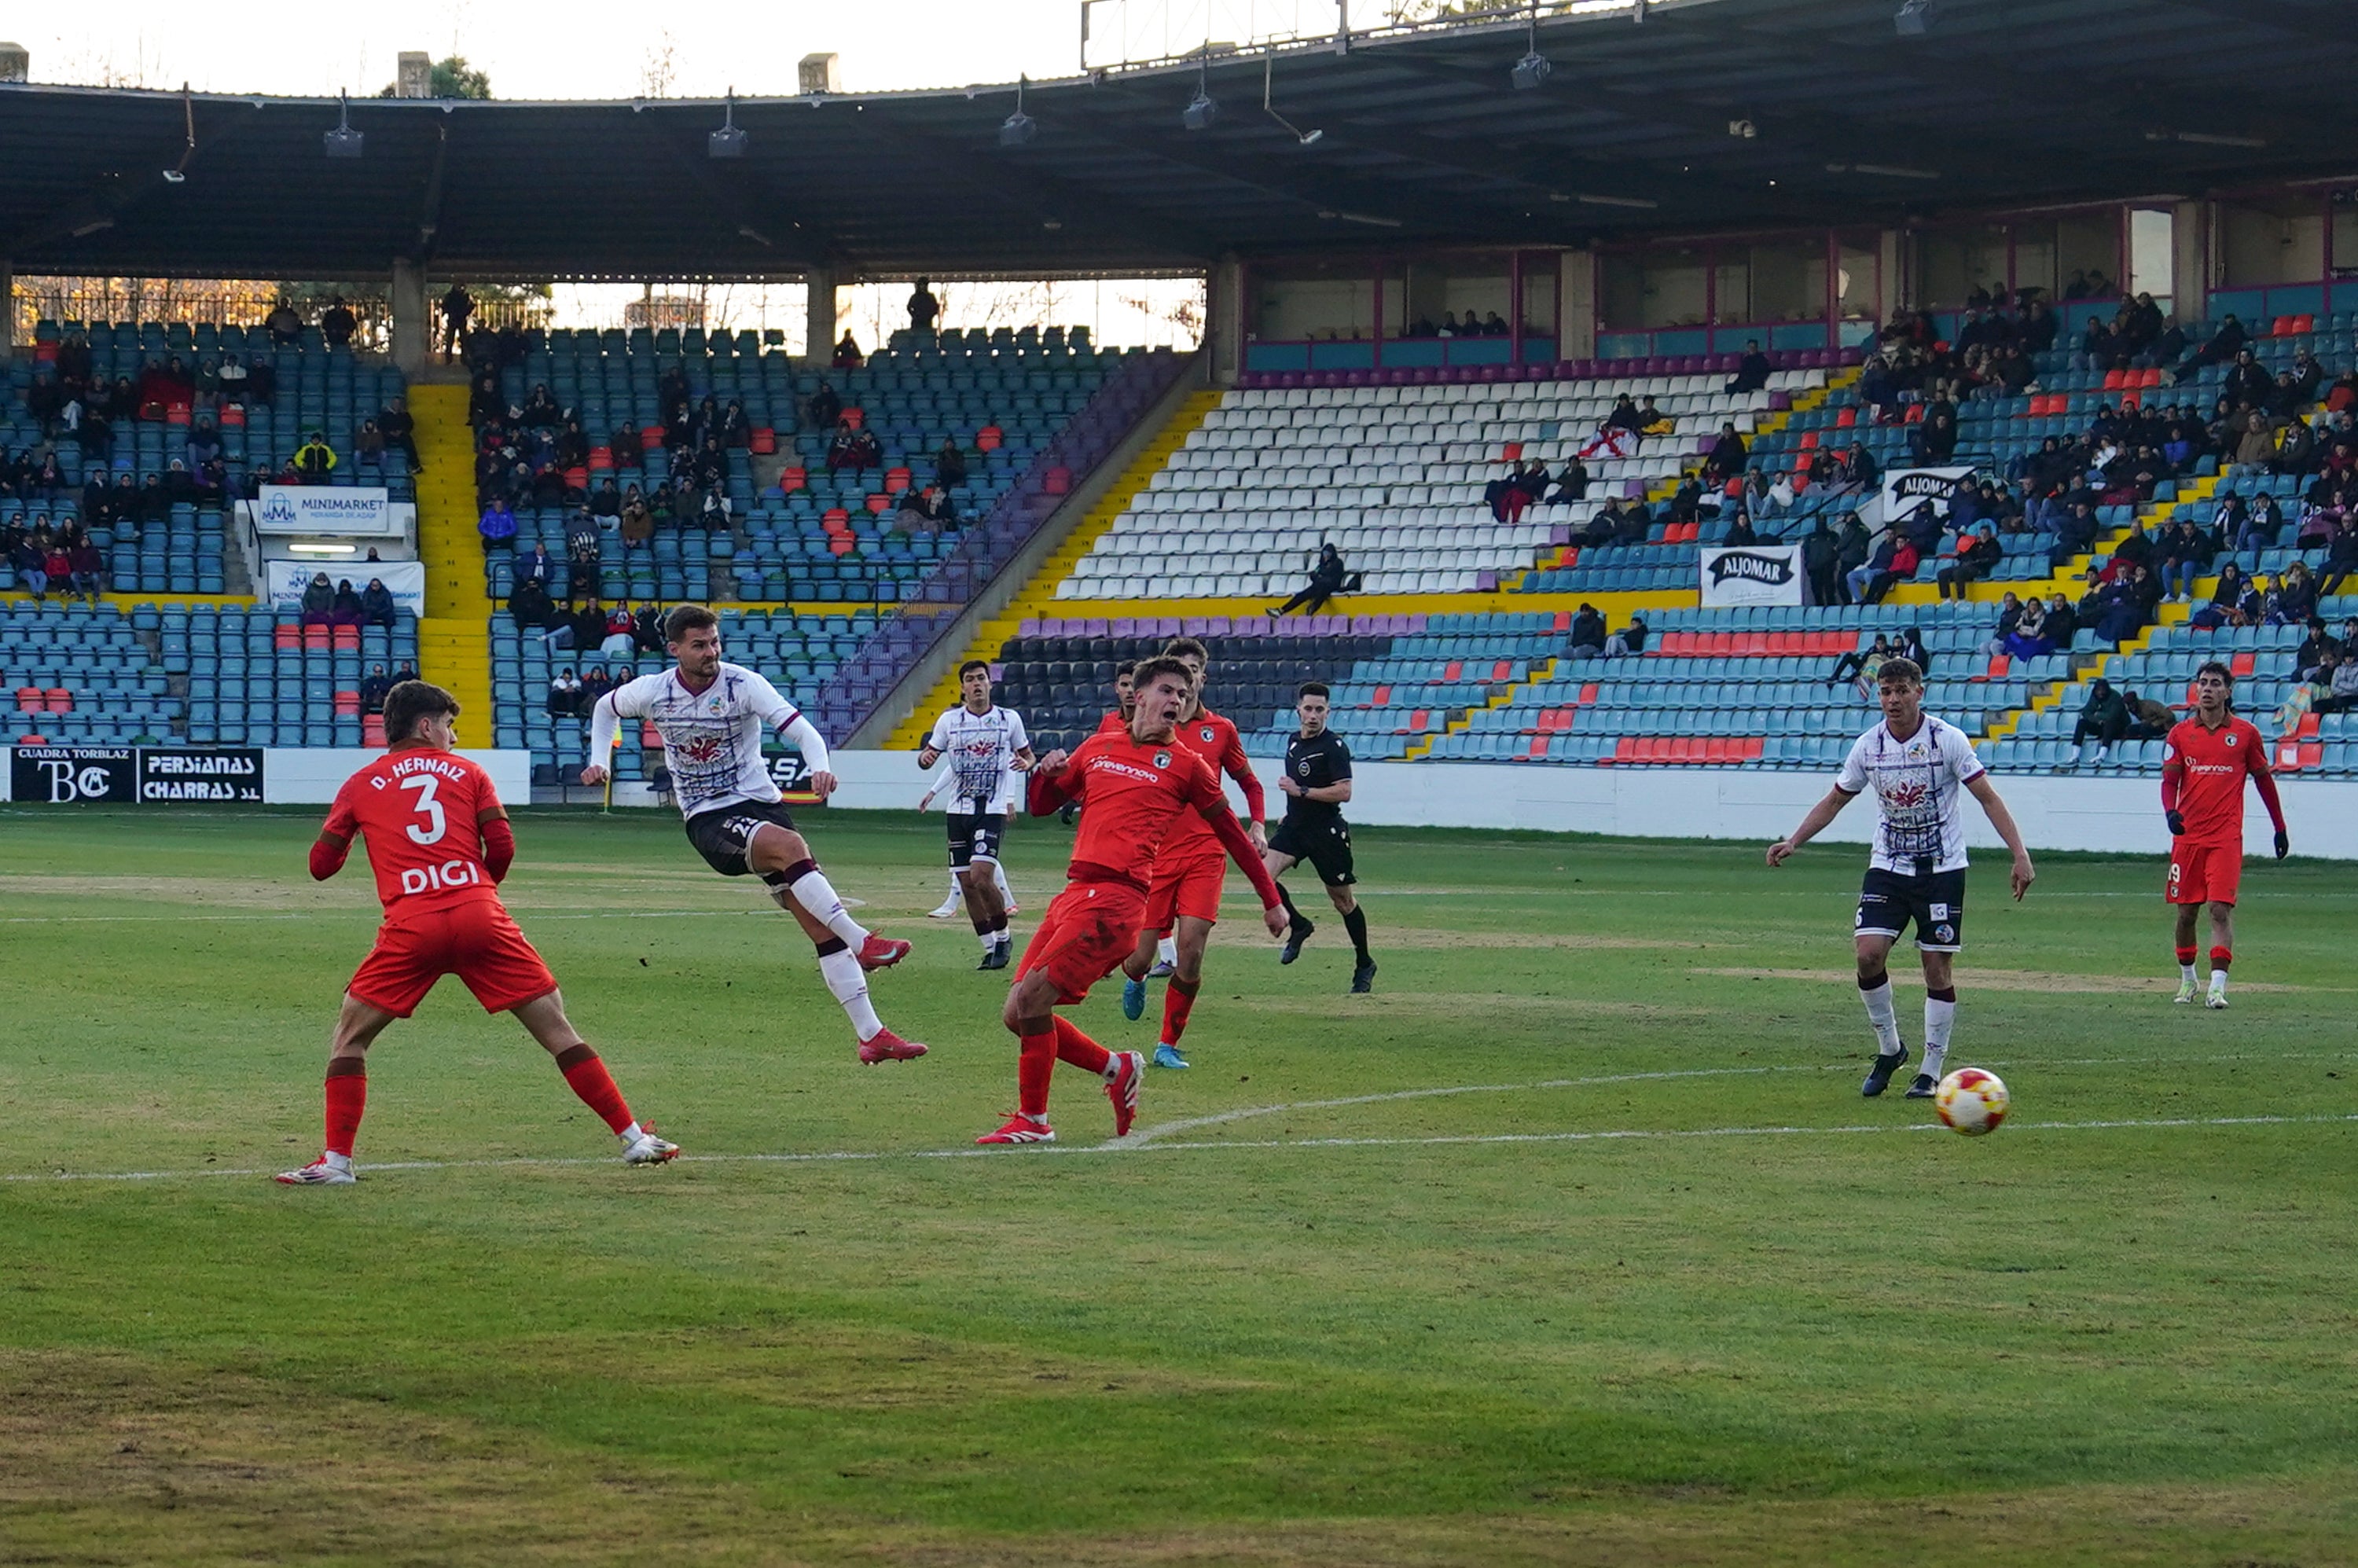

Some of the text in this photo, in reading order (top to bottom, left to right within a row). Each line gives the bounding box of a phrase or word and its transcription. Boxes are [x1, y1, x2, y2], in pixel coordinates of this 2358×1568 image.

[302, 499, 384, 510] MINIMARKET
[1723, 556, 1781, 581] ALJOMAR
[18, 748, 129, 759] CUADRA TORBLAZ
[370, 757, 466, 791] D. HERNAIZ
[1093, 760, 1159, 783] prevennova
[143, 781, 235, 799] CHARRAS
[400, 773, 446, 845] 3
[402, 860, 479, 894] DIGI
